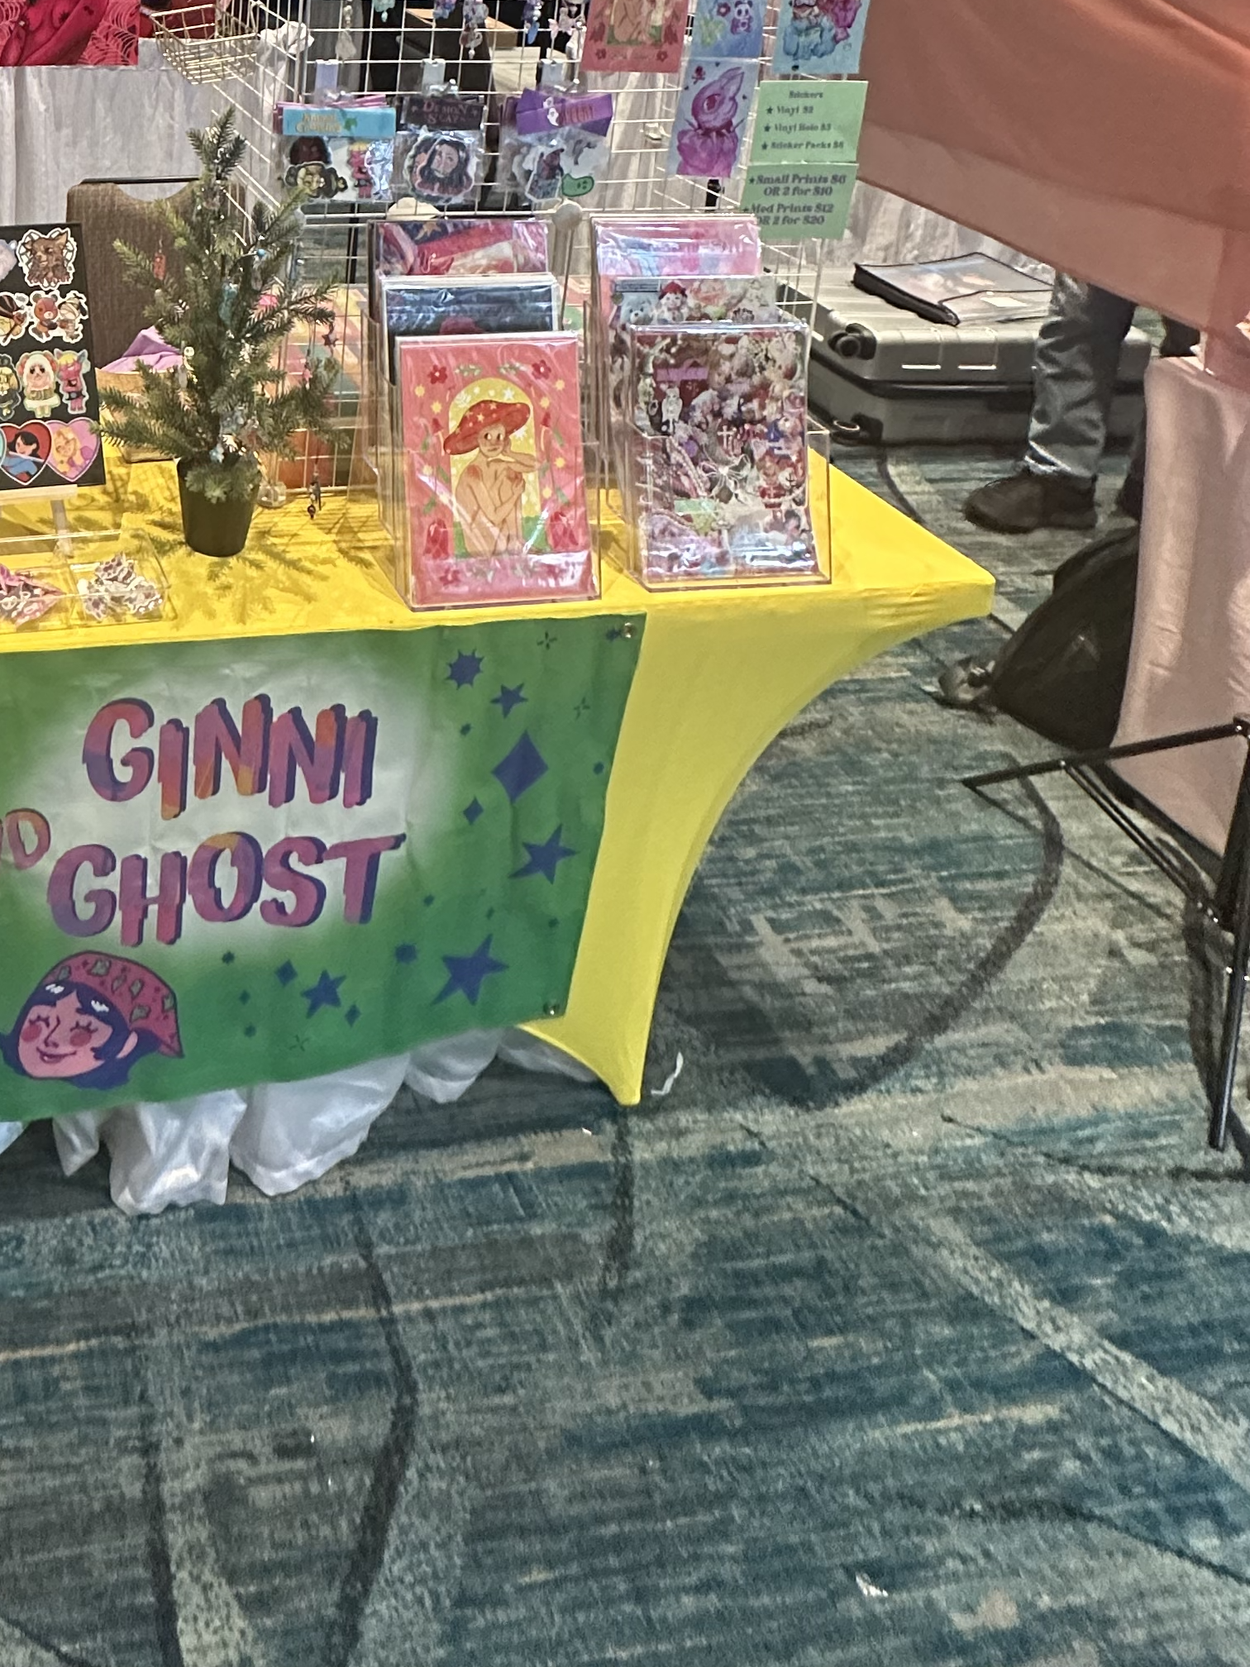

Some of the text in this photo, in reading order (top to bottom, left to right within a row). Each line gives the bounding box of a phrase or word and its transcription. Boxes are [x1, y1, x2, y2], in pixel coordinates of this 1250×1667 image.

[788, 90, 823, 99] Stickers
[776, 106, 800, 117] Vinyl
[774, 123, 797, 134] Vinyl
[770, 141, 804, 149] Sticker
[805, 141, 831, 149] Packs
[756, 174, 790, 185] Small
[792, 174, 829, 185] Prints
[763, 185, 833, 197] OR 2 for $10
[751, 203, 834, 213] Med Prints $12
[772, 215, 781, 225] 2
[781, 215, 800, 226] for
[802, 215, 825, 225] $20
[82, 695, 378, 820] GINNI
[46, 830, 407, 948] GHOST
